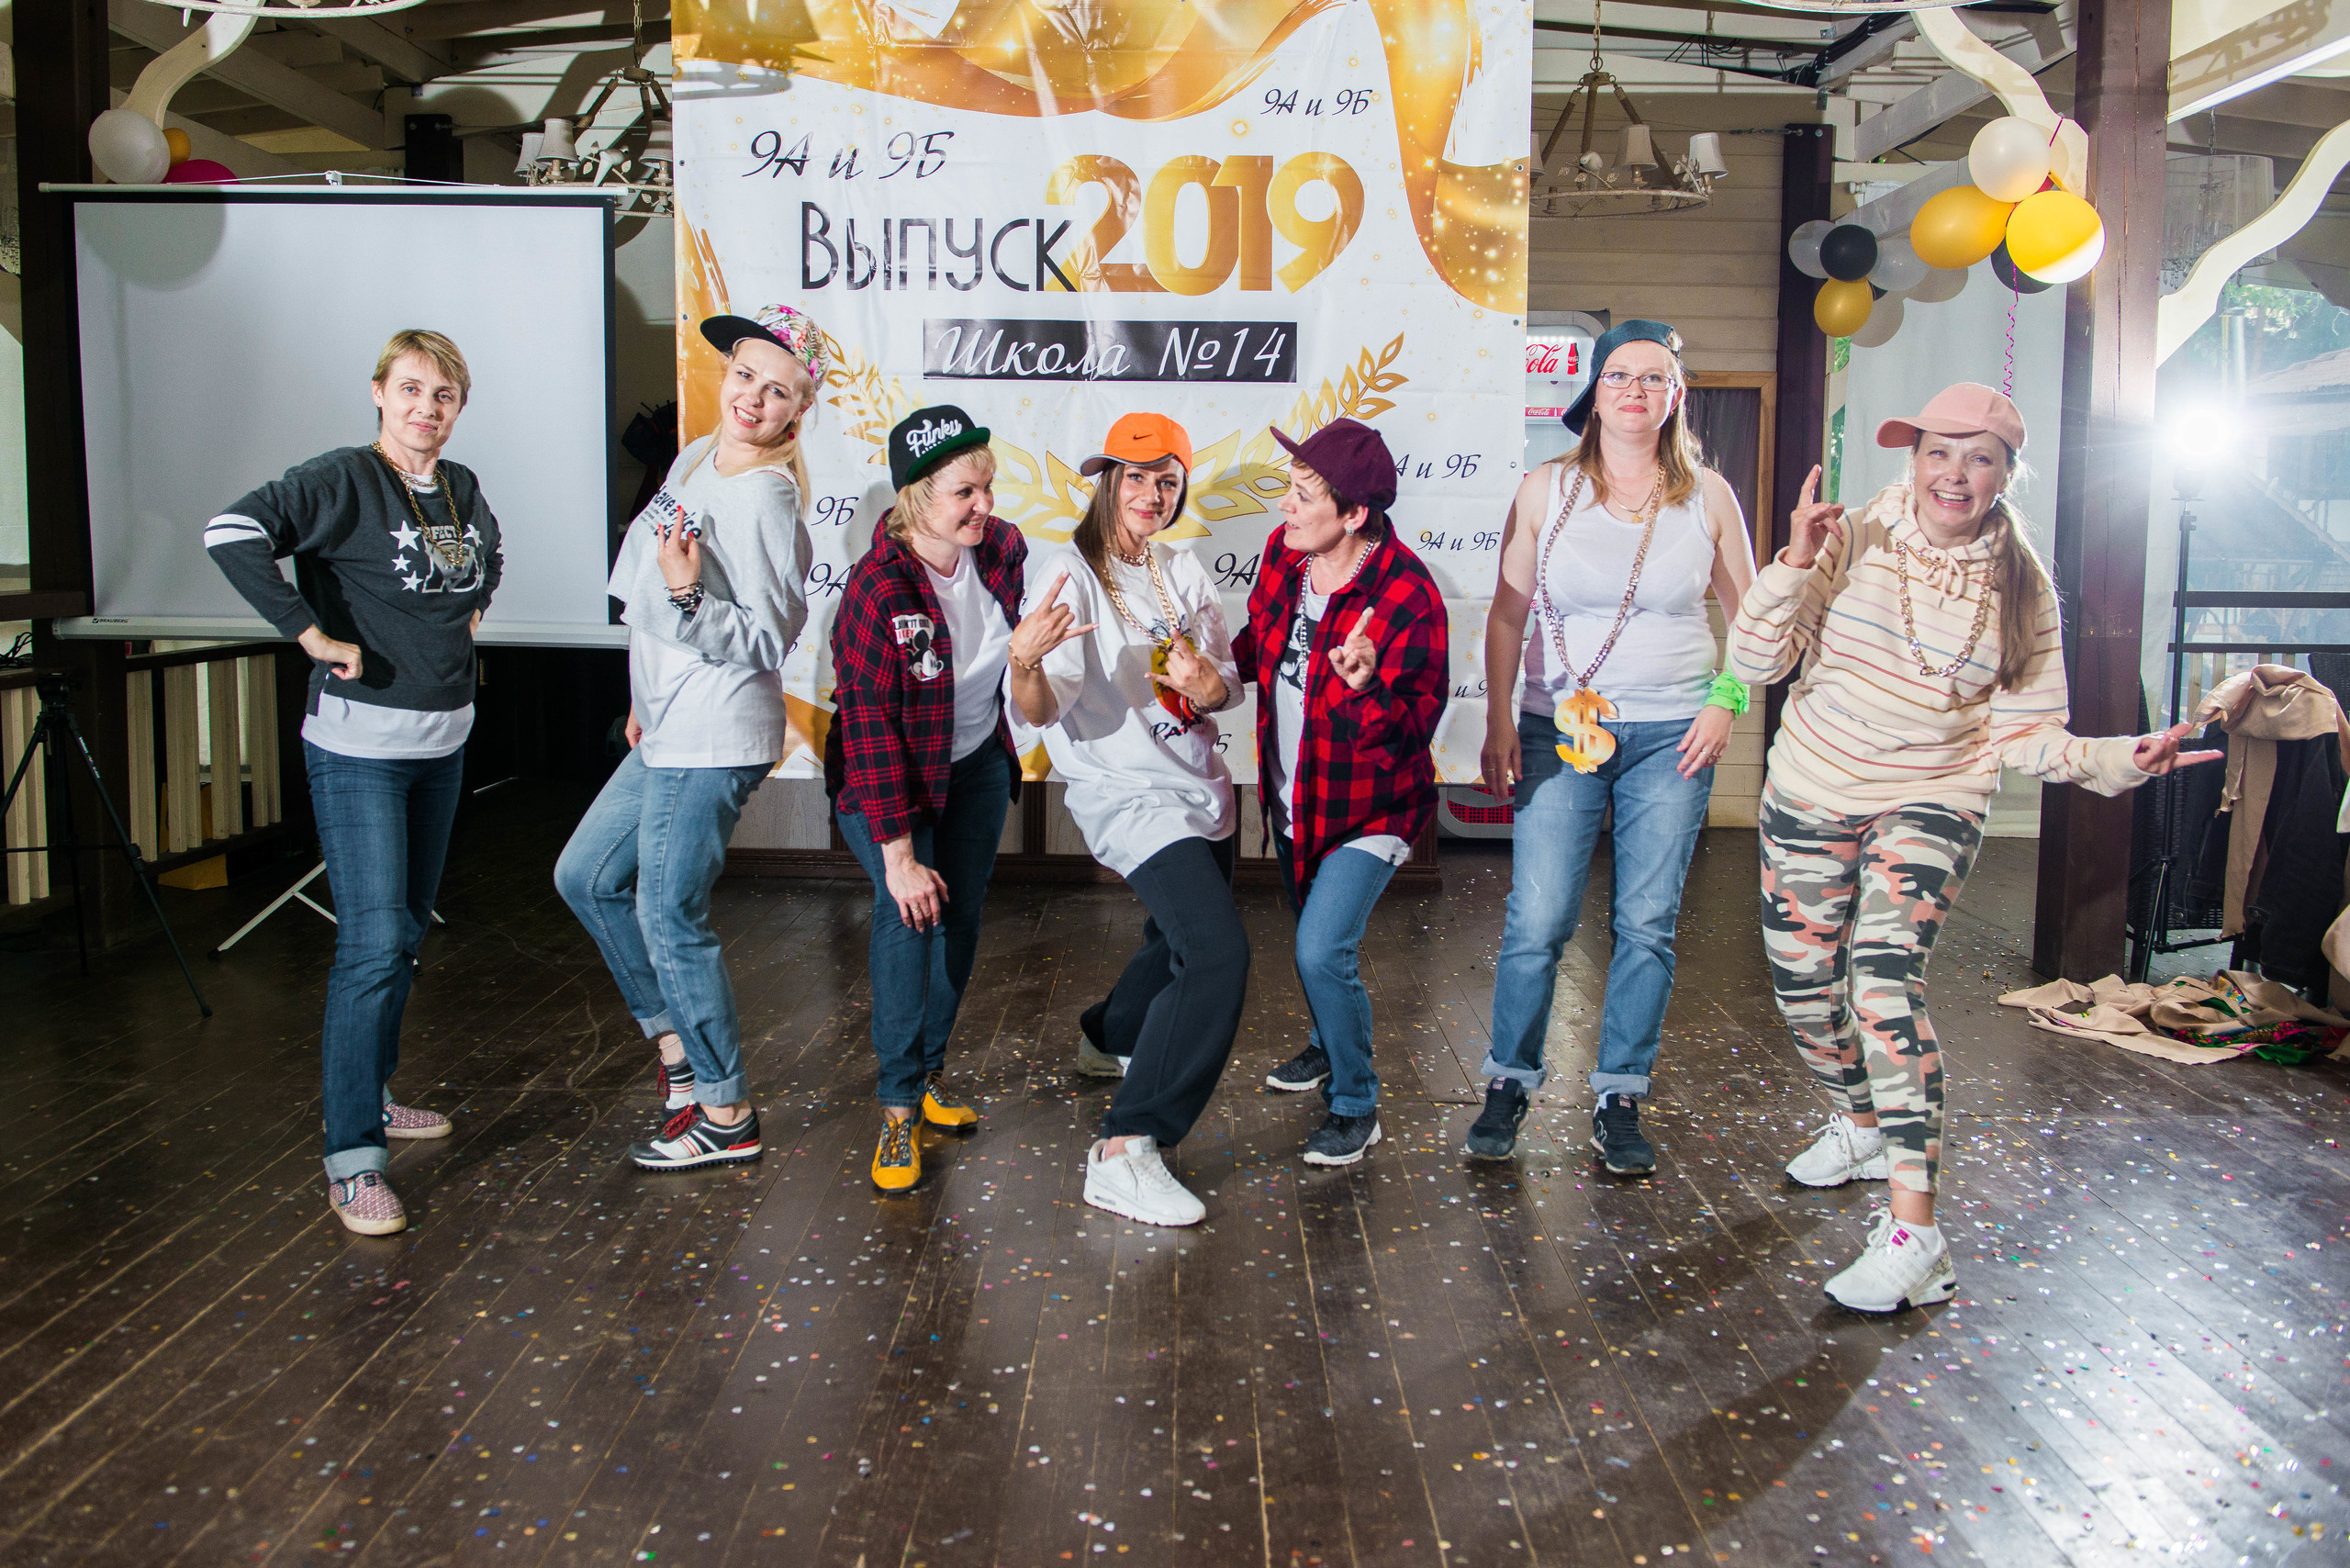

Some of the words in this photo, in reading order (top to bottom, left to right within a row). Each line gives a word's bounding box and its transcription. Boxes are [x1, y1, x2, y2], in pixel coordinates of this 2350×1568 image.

[1259, 88, 1299, 116] 9А
[1304, 97, 1325, 117] и
[1332, 88, 1373, 117] 9Б
[742, 130, 814, 179] 9А
[828, 147, 864, 180] и
[878, 130, 956, 180] 9Б
[1043, 151, 1365, 297] 2019
[934, 325, 1131, 377] Школа
[905, 418, 963, 458] Funky
[1394, 454, 1410, 477] А
[1416, 462, 1435, 479] и
[1440, 454, 1482, 479] 9Б
[811, 496, 859, 526] 9Б
[1416, 531, 1446, 551] 9А
[1449, 538, 1465, 551] и
[1470, 531, 1501, 551] 9Б
[1214, 553, 1260, 588] 9А
